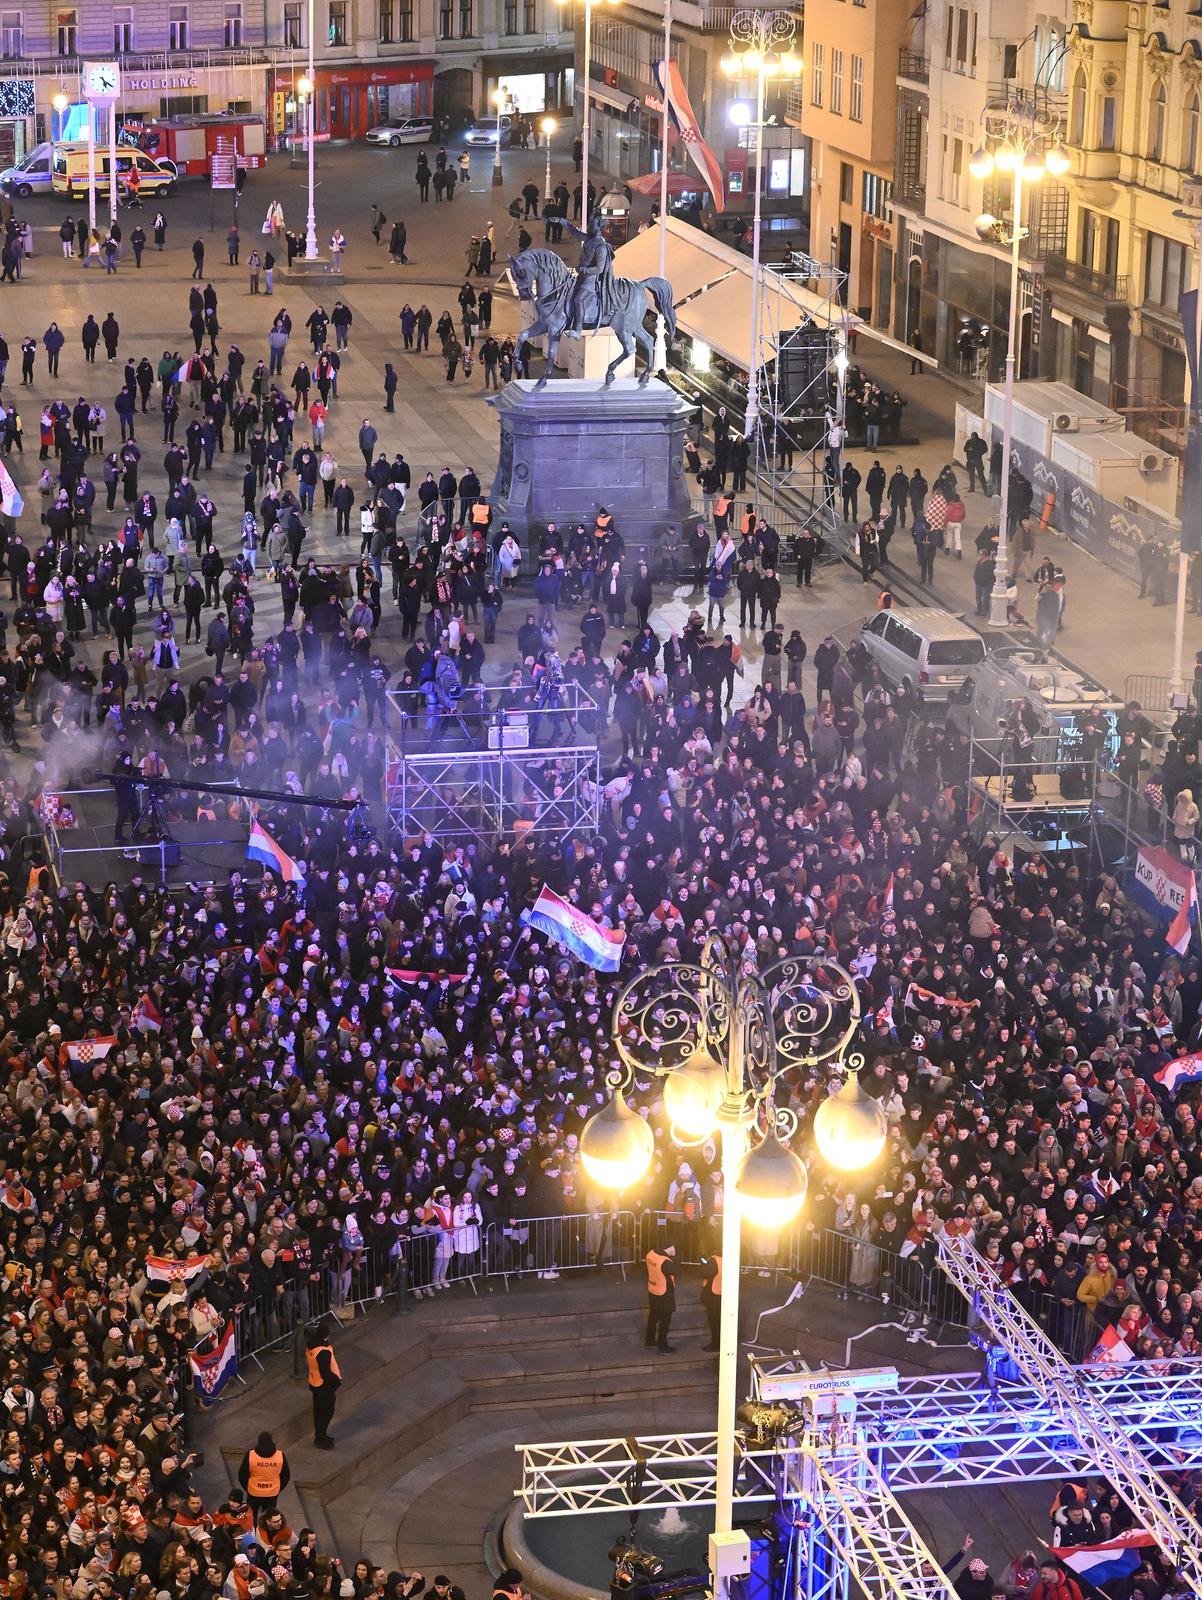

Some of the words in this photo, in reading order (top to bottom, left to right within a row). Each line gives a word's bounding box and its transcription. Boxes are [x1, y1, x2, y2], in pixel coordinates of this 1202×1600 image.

[131, 78, 197, 90] HOLDING
[1137, 862, 1153, 882] KUP
[809, 1380, 850, 1390] EUROTRUSS
